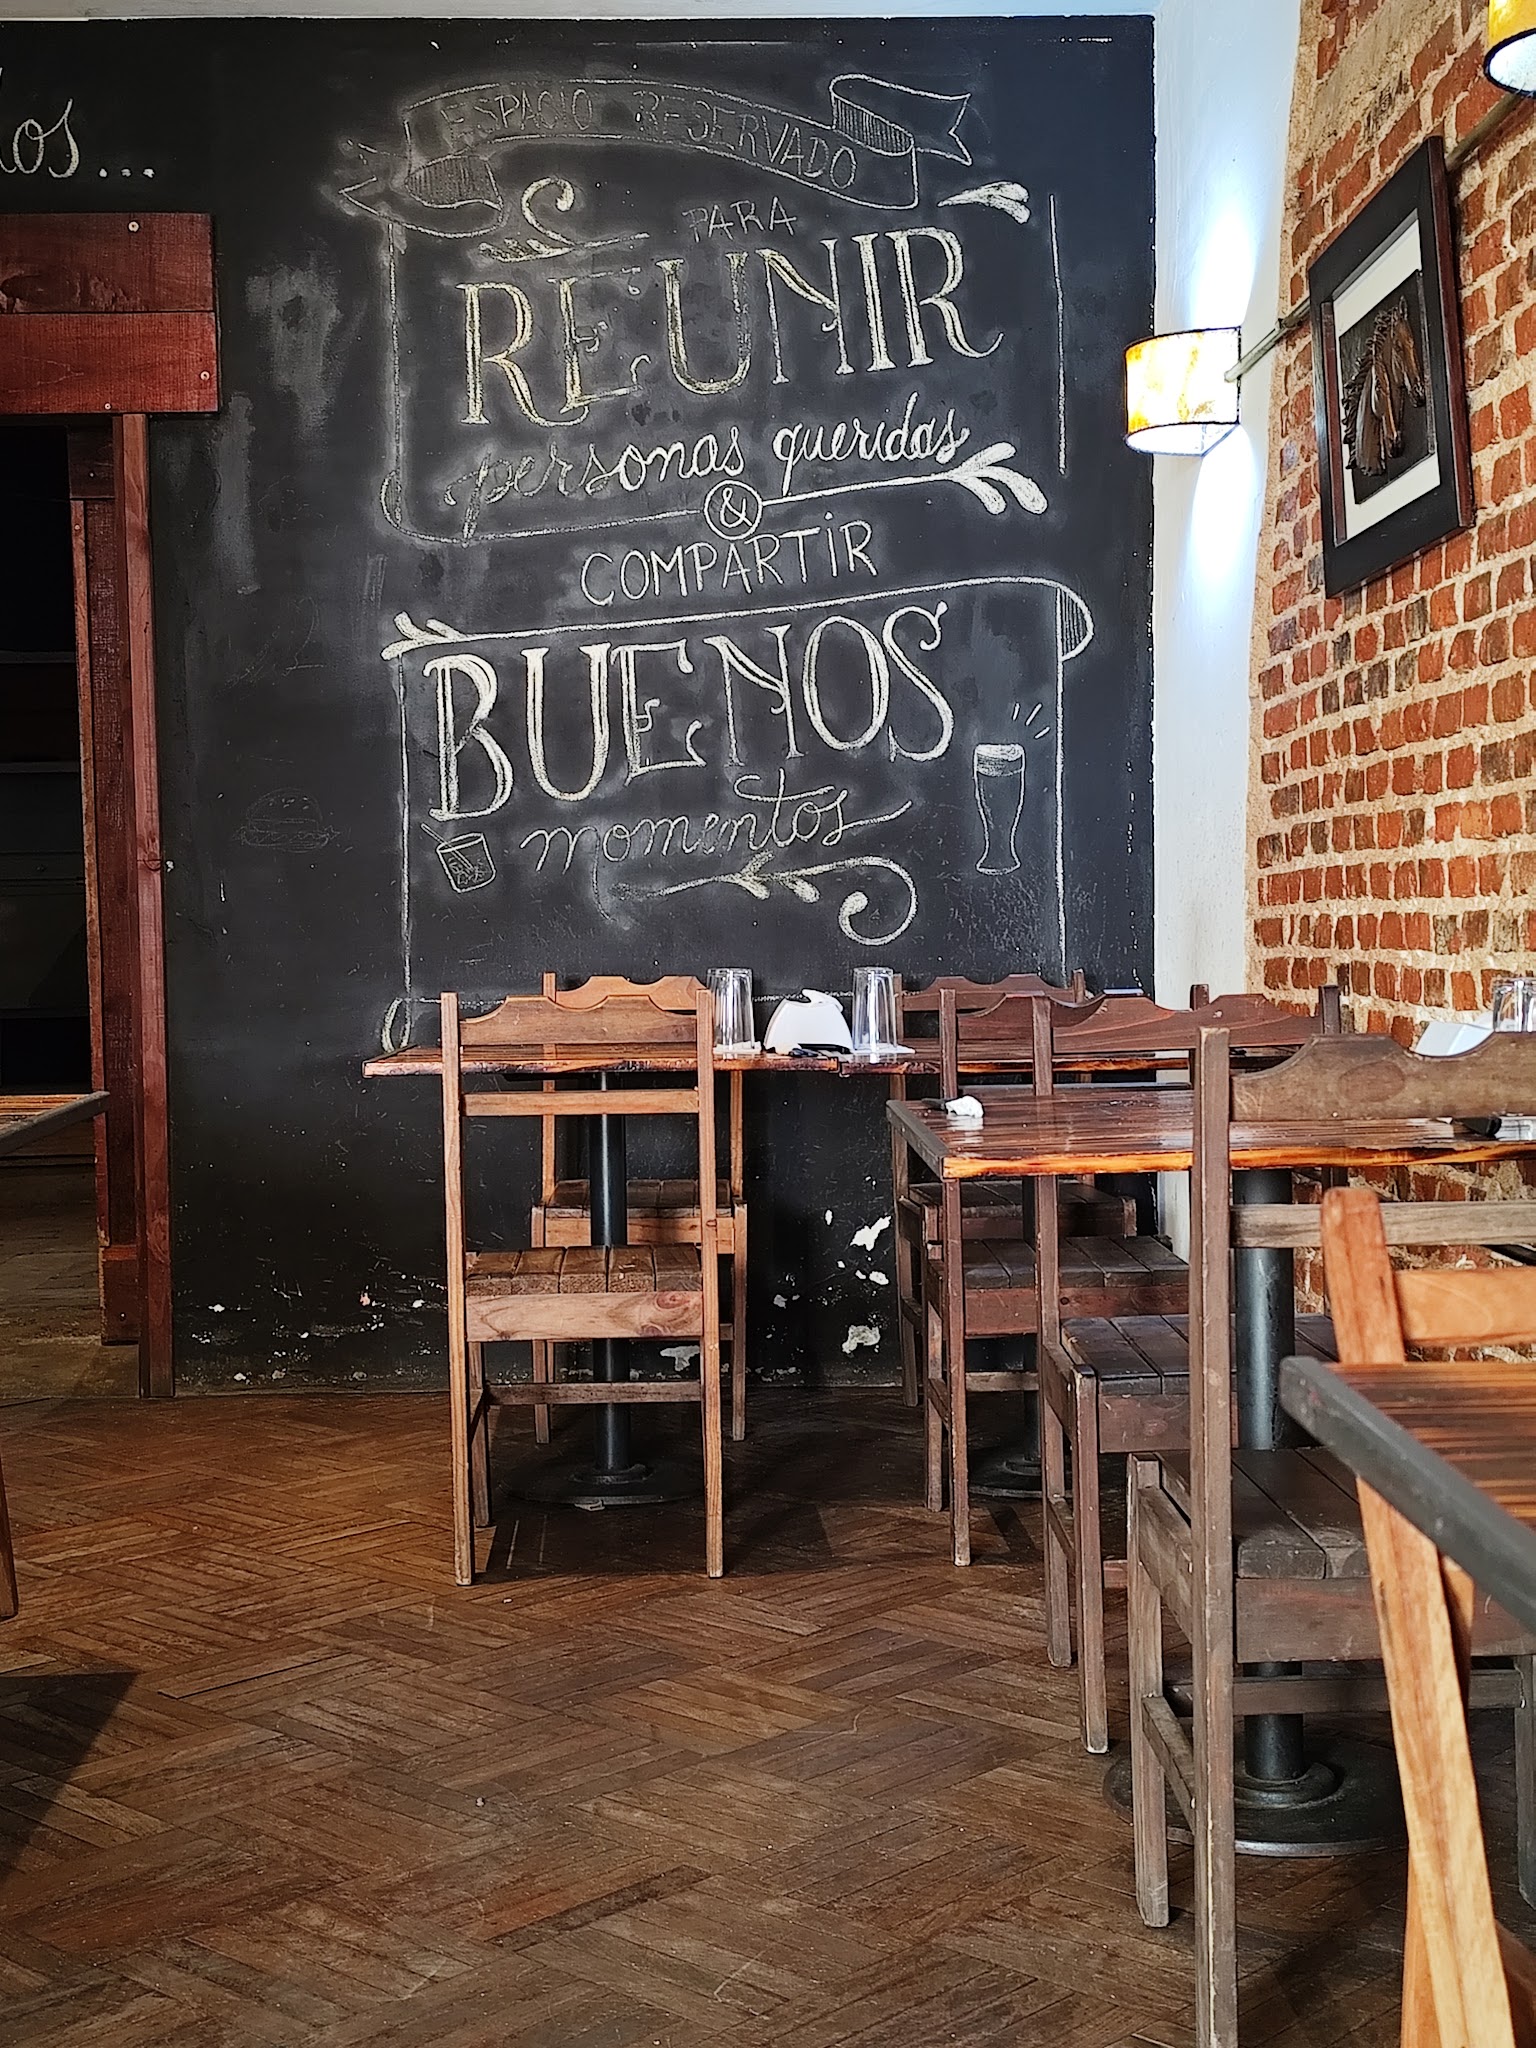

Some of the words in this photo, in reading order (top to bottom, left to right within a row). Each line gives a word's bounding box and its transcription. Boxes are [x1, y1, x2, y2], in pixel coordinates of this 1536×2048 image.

[440, 88, 595, 150] ESPACIO
[632, 88, 858, 190] RESERVADO
[682, 196, 798, 243] PARA
[455, 226, 1004, 426] REUNIR
[443, 426, 746, 548] personas
[771, 391, 970, 498] queridas
[421, 601, 956, 822] BUENOS
[519, 768, 912, 890] momentos
